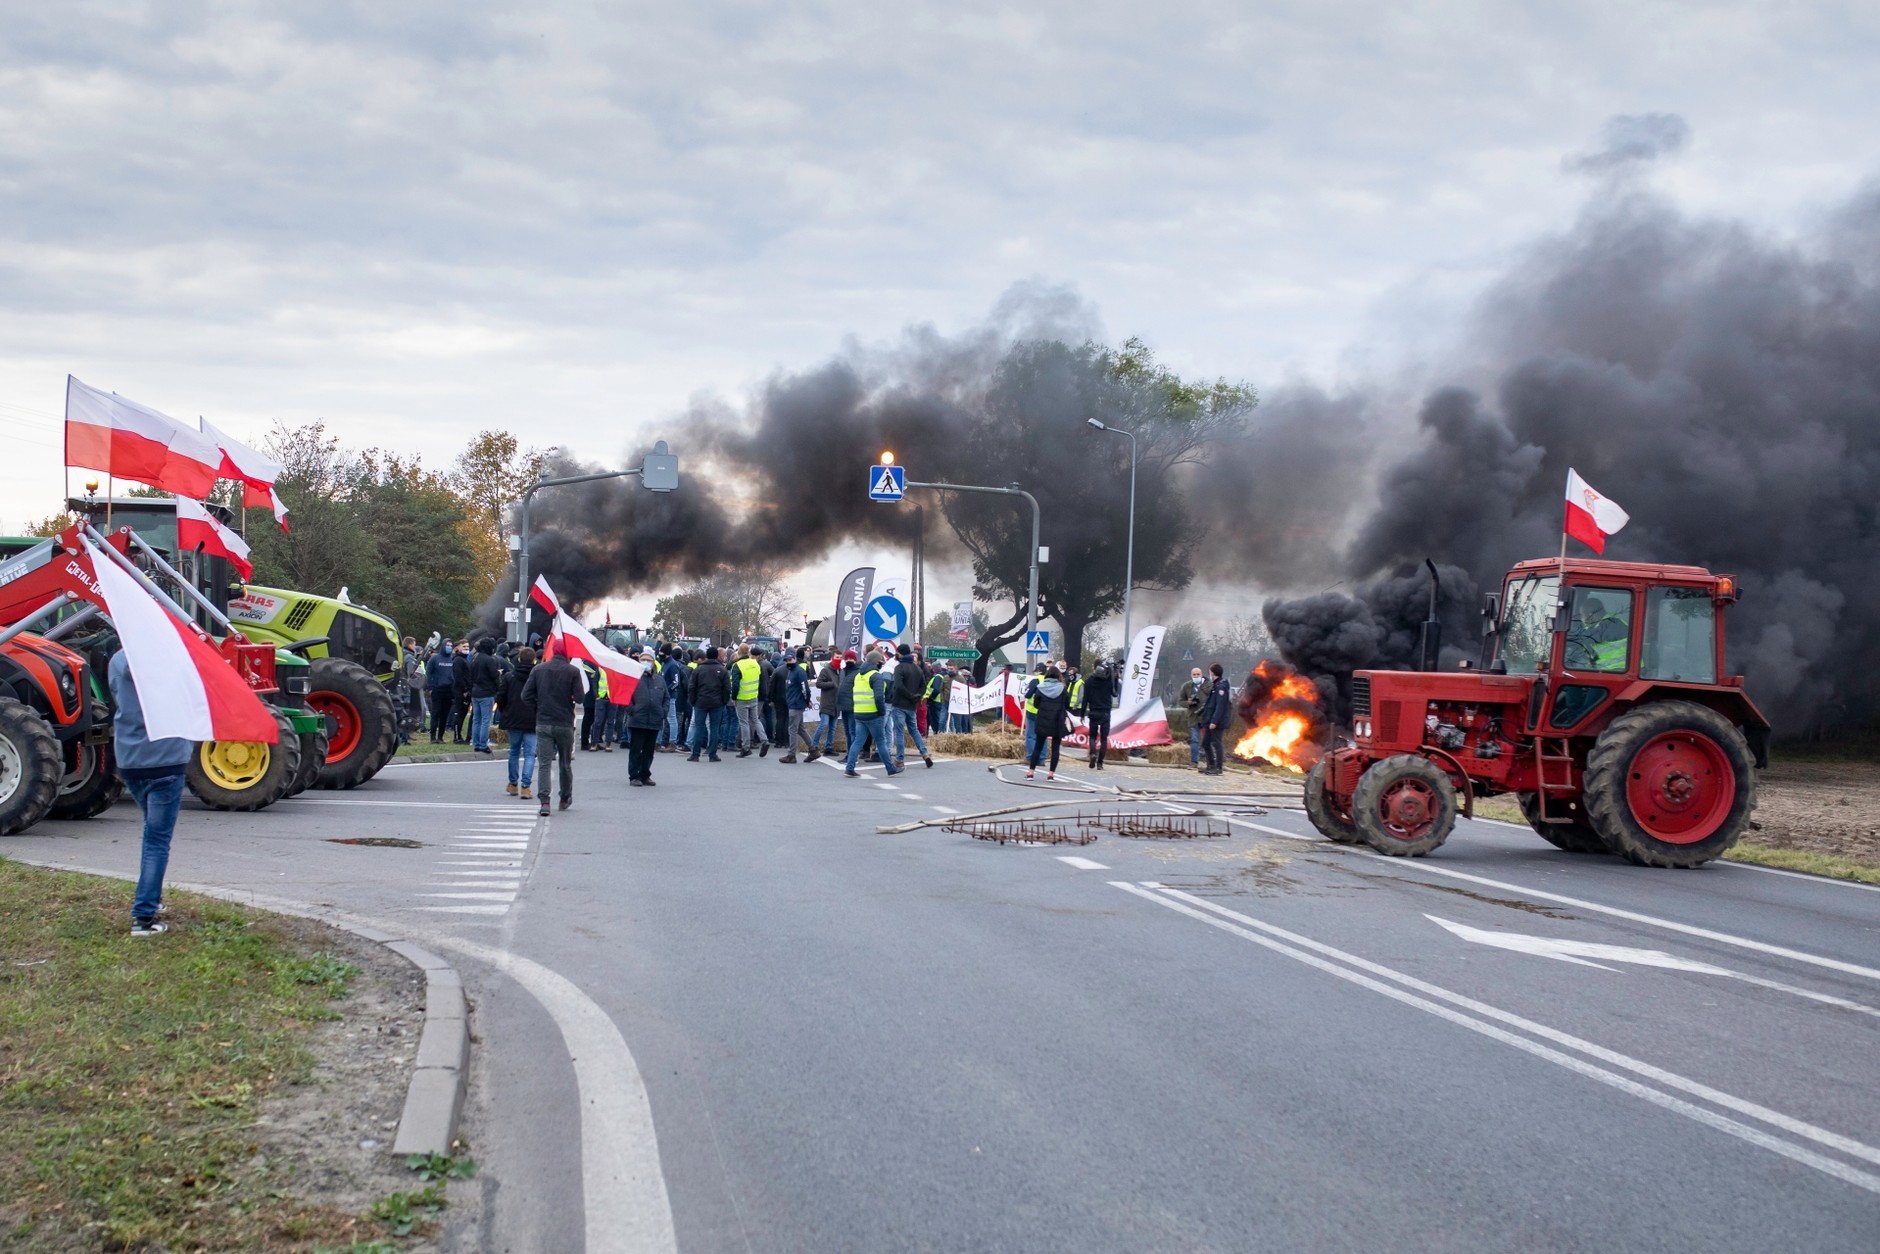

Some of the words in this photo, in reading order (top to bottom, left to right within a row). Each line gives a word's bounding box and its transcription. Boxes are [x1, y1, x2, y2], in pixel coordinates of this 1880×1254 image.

[65, 560, 106, 598] METAL-T
[238, 594, 275, 608] AAS
[238, 611, 263, 620] AXION
[1135, 636, 1156, 704] GROUNIA
